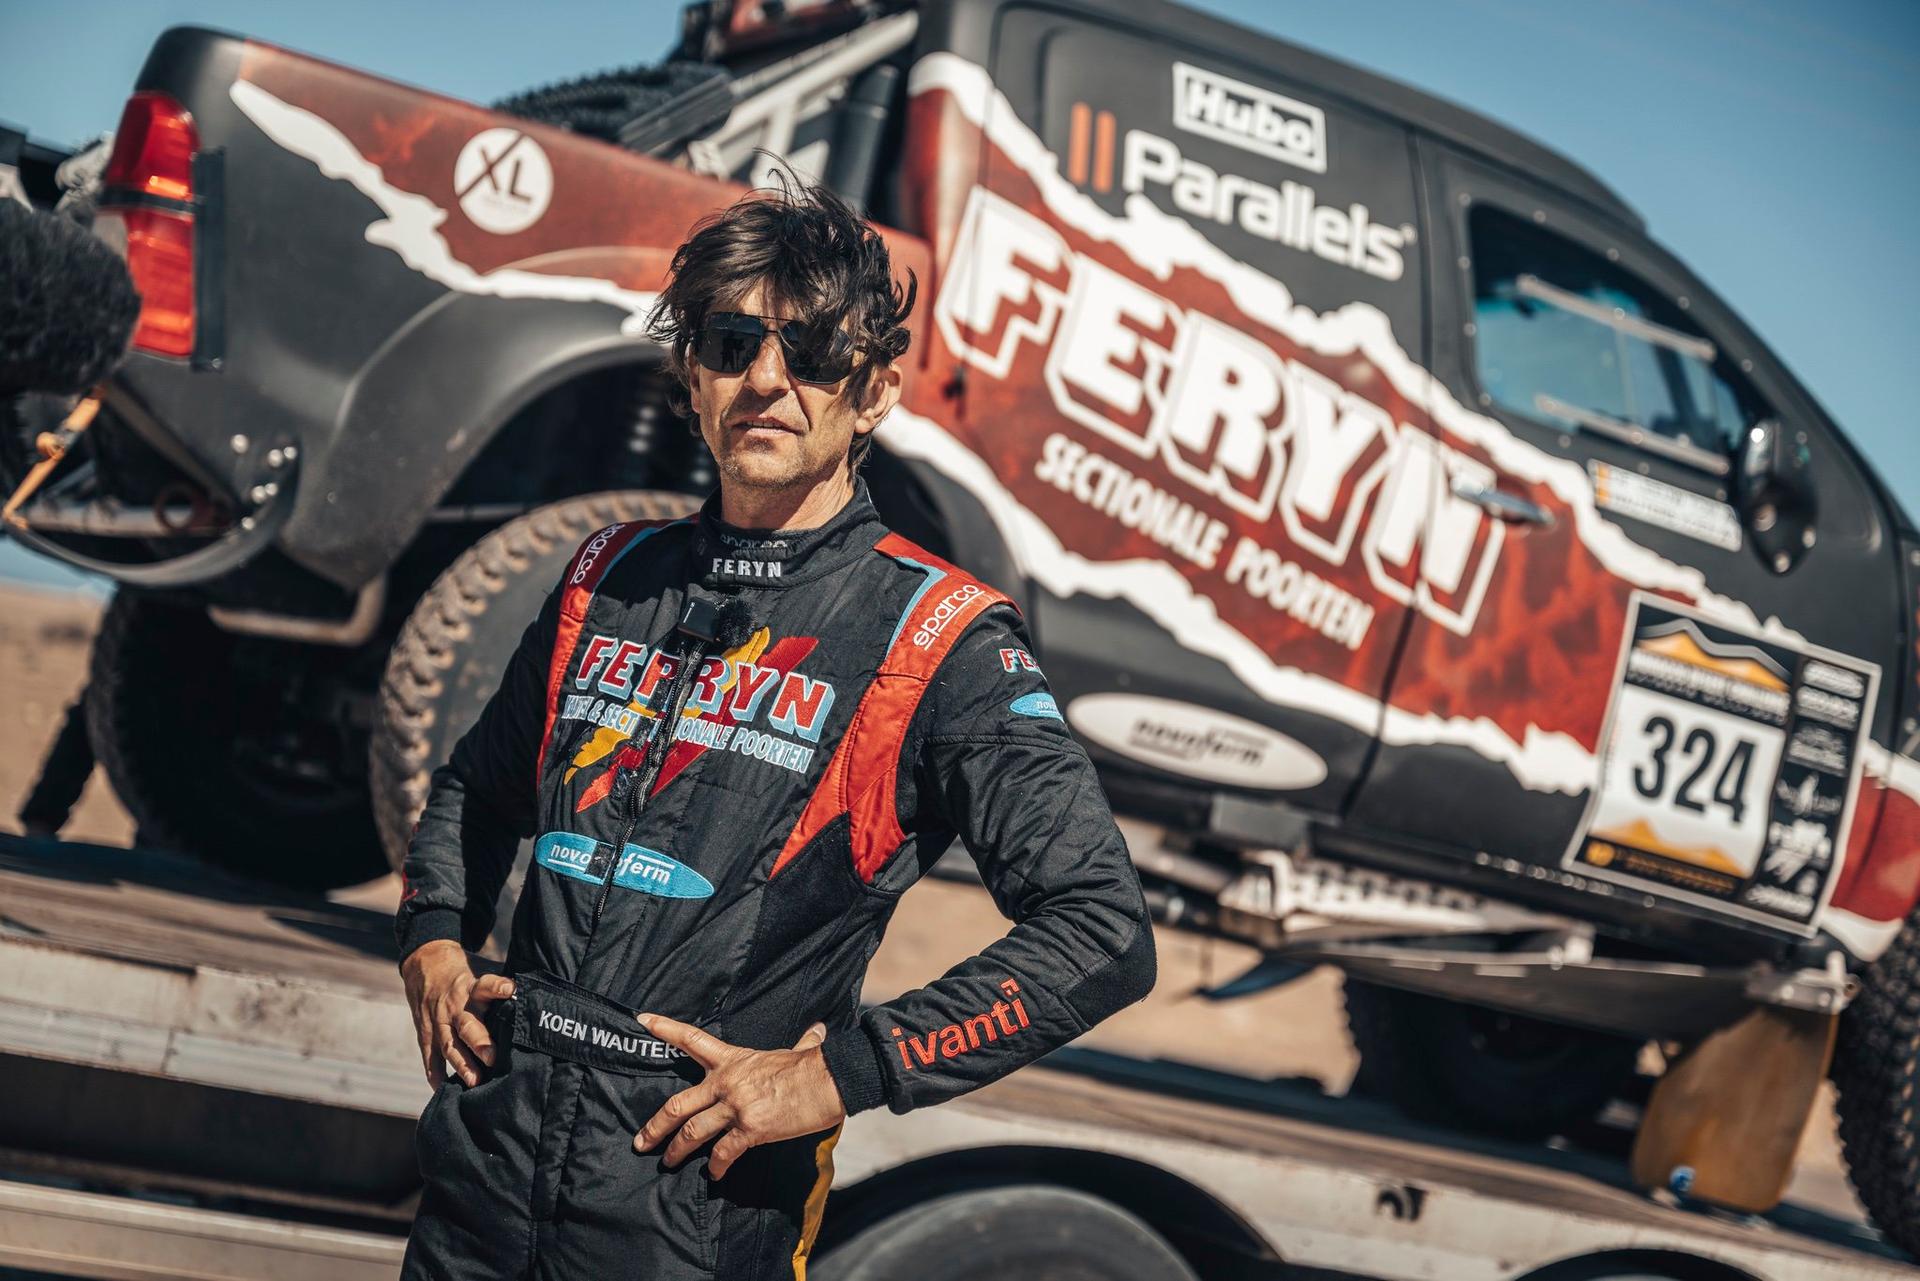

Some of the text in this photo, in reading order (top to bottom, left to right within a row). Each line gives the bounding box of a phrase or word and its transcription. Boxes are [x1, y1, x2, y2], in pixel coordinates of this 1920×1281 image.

[1188, 79, 1313, 153] Hubo
[468, 138, 532, 204] XL
[1124, 129, 1404, 282] Parallels
[936, 185, 1504, 635] FERYN
[712, 558, 781, 578] FERYN
[1034, 433, 1374, 649] SECTIONALE POORTEN
[913, 584, 985, 650] sparco
[587, 699, 605, 723] &
[732, 727, 815, 774] POORTEN
[1632, 715, 1760, 827] 324
[538, 1009, 588, 1042] KOEN
[892, 978, 1032, 1070] ivanti
